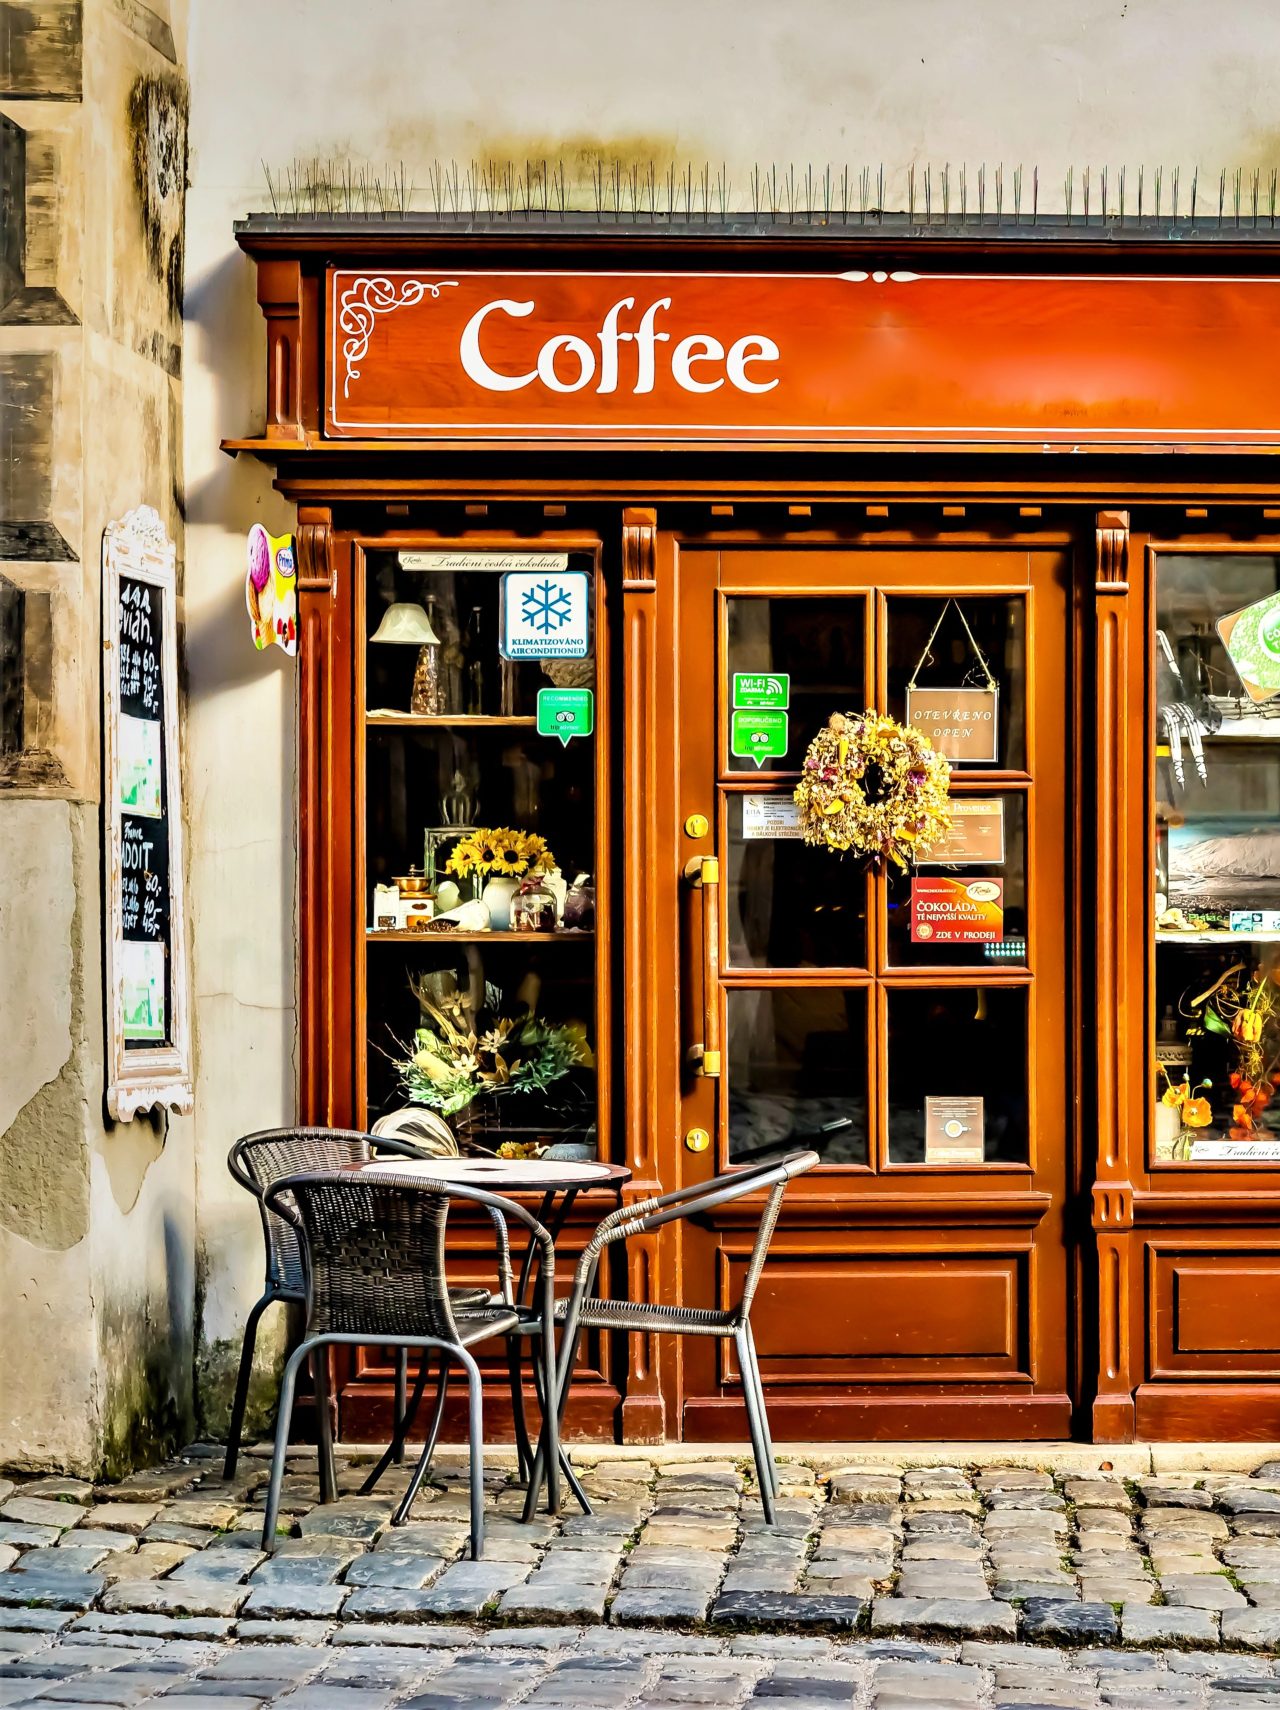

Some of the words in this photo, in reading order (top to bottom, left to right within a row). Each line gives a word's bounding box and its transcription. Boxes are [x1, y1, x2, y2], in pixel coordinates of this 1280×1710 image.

[459, 296, 780, 394] Coffee
[511, 638, 584, 646] KLIMATIZOVÁNO
[511, 647, 585, 655] AIRCONDITIONED
[740, 678, 766, 688] WI-FI
[914, 708, 993, 721] OTEVŘENO
[933, 728, 974, 738] OPEN
[916, 900, 978, 912] ČOKOLÁDA
[917, 913, 926, 921] TÉ
[926, 912, 957, 922] NEJVYŠŠÍ
[958, 913, 987, 921] KVALITY
[936, 931, 952, 939] ZDE
[955, 931, 961, 939] V
[963, 931, 996, 940] PRODEJI
